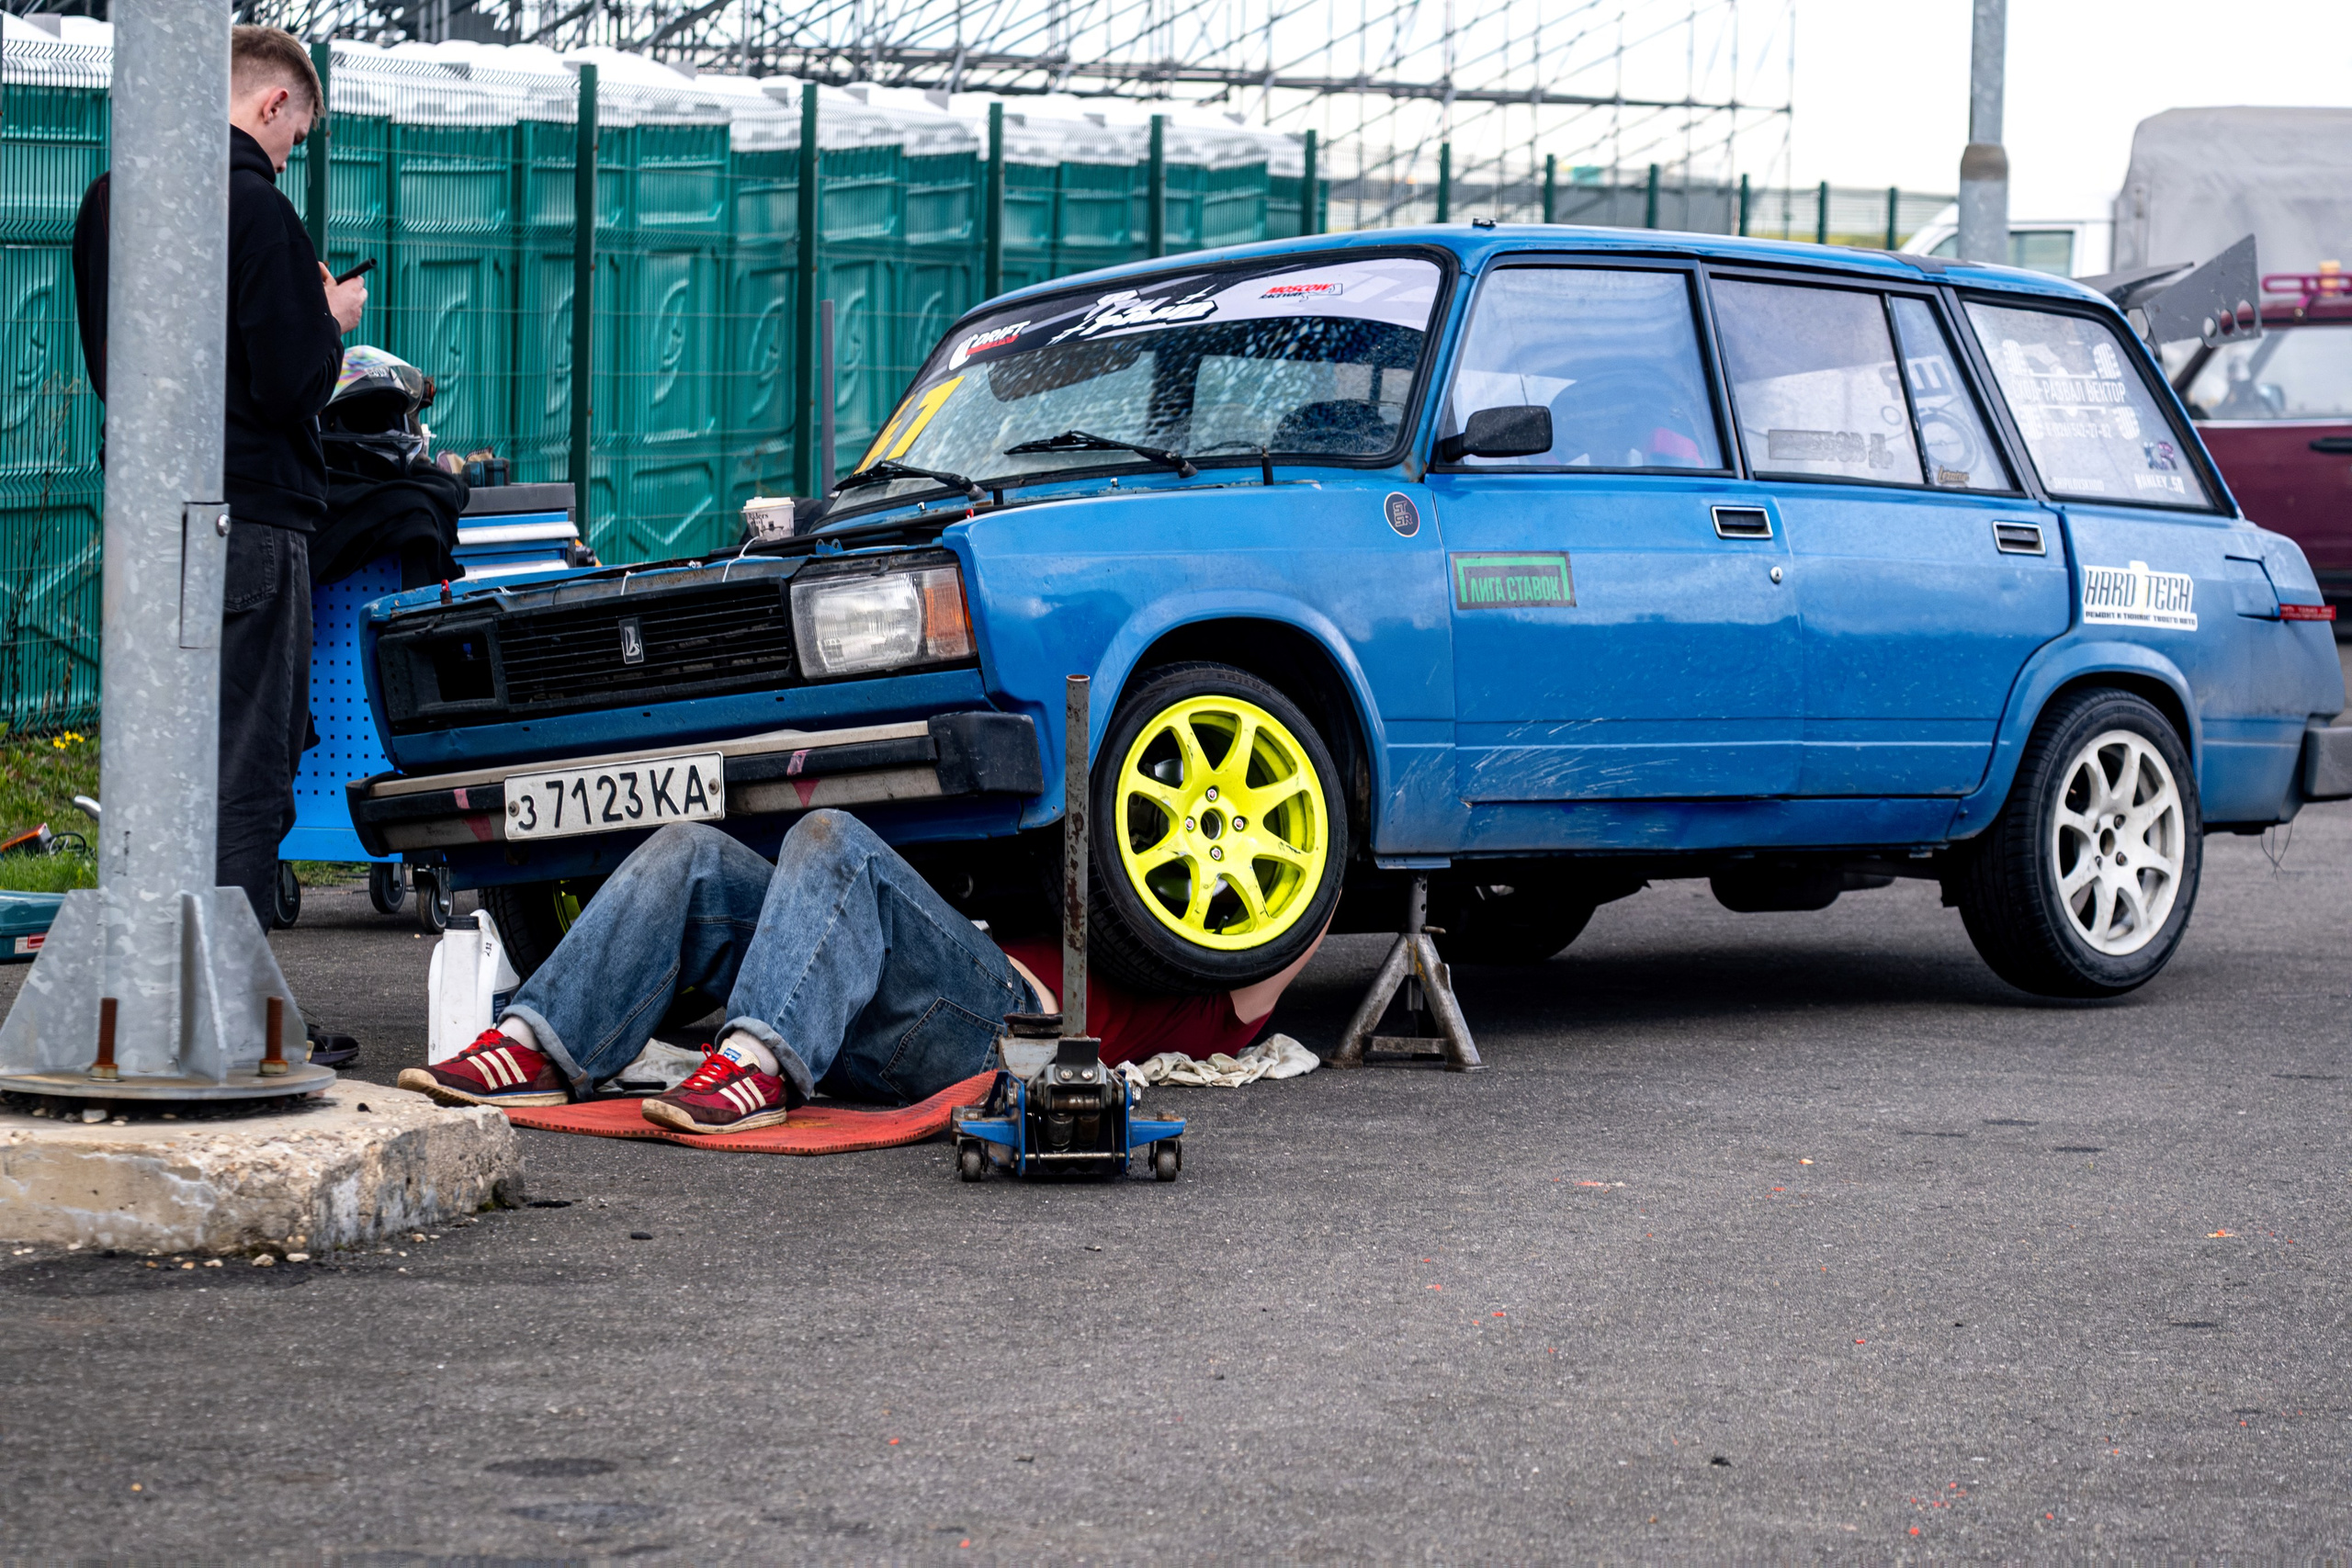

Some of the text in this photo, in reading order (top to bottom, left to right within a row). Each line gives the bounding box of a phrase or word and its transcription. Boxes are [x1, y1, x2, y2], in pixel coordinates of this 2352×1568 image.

[2086, 380, 2126, 403] ВЕКТОР
[1470, 574, 1562, 603] ЛИГА СТАВОК
[2084, 570, 2190, 613] HARD TECH
